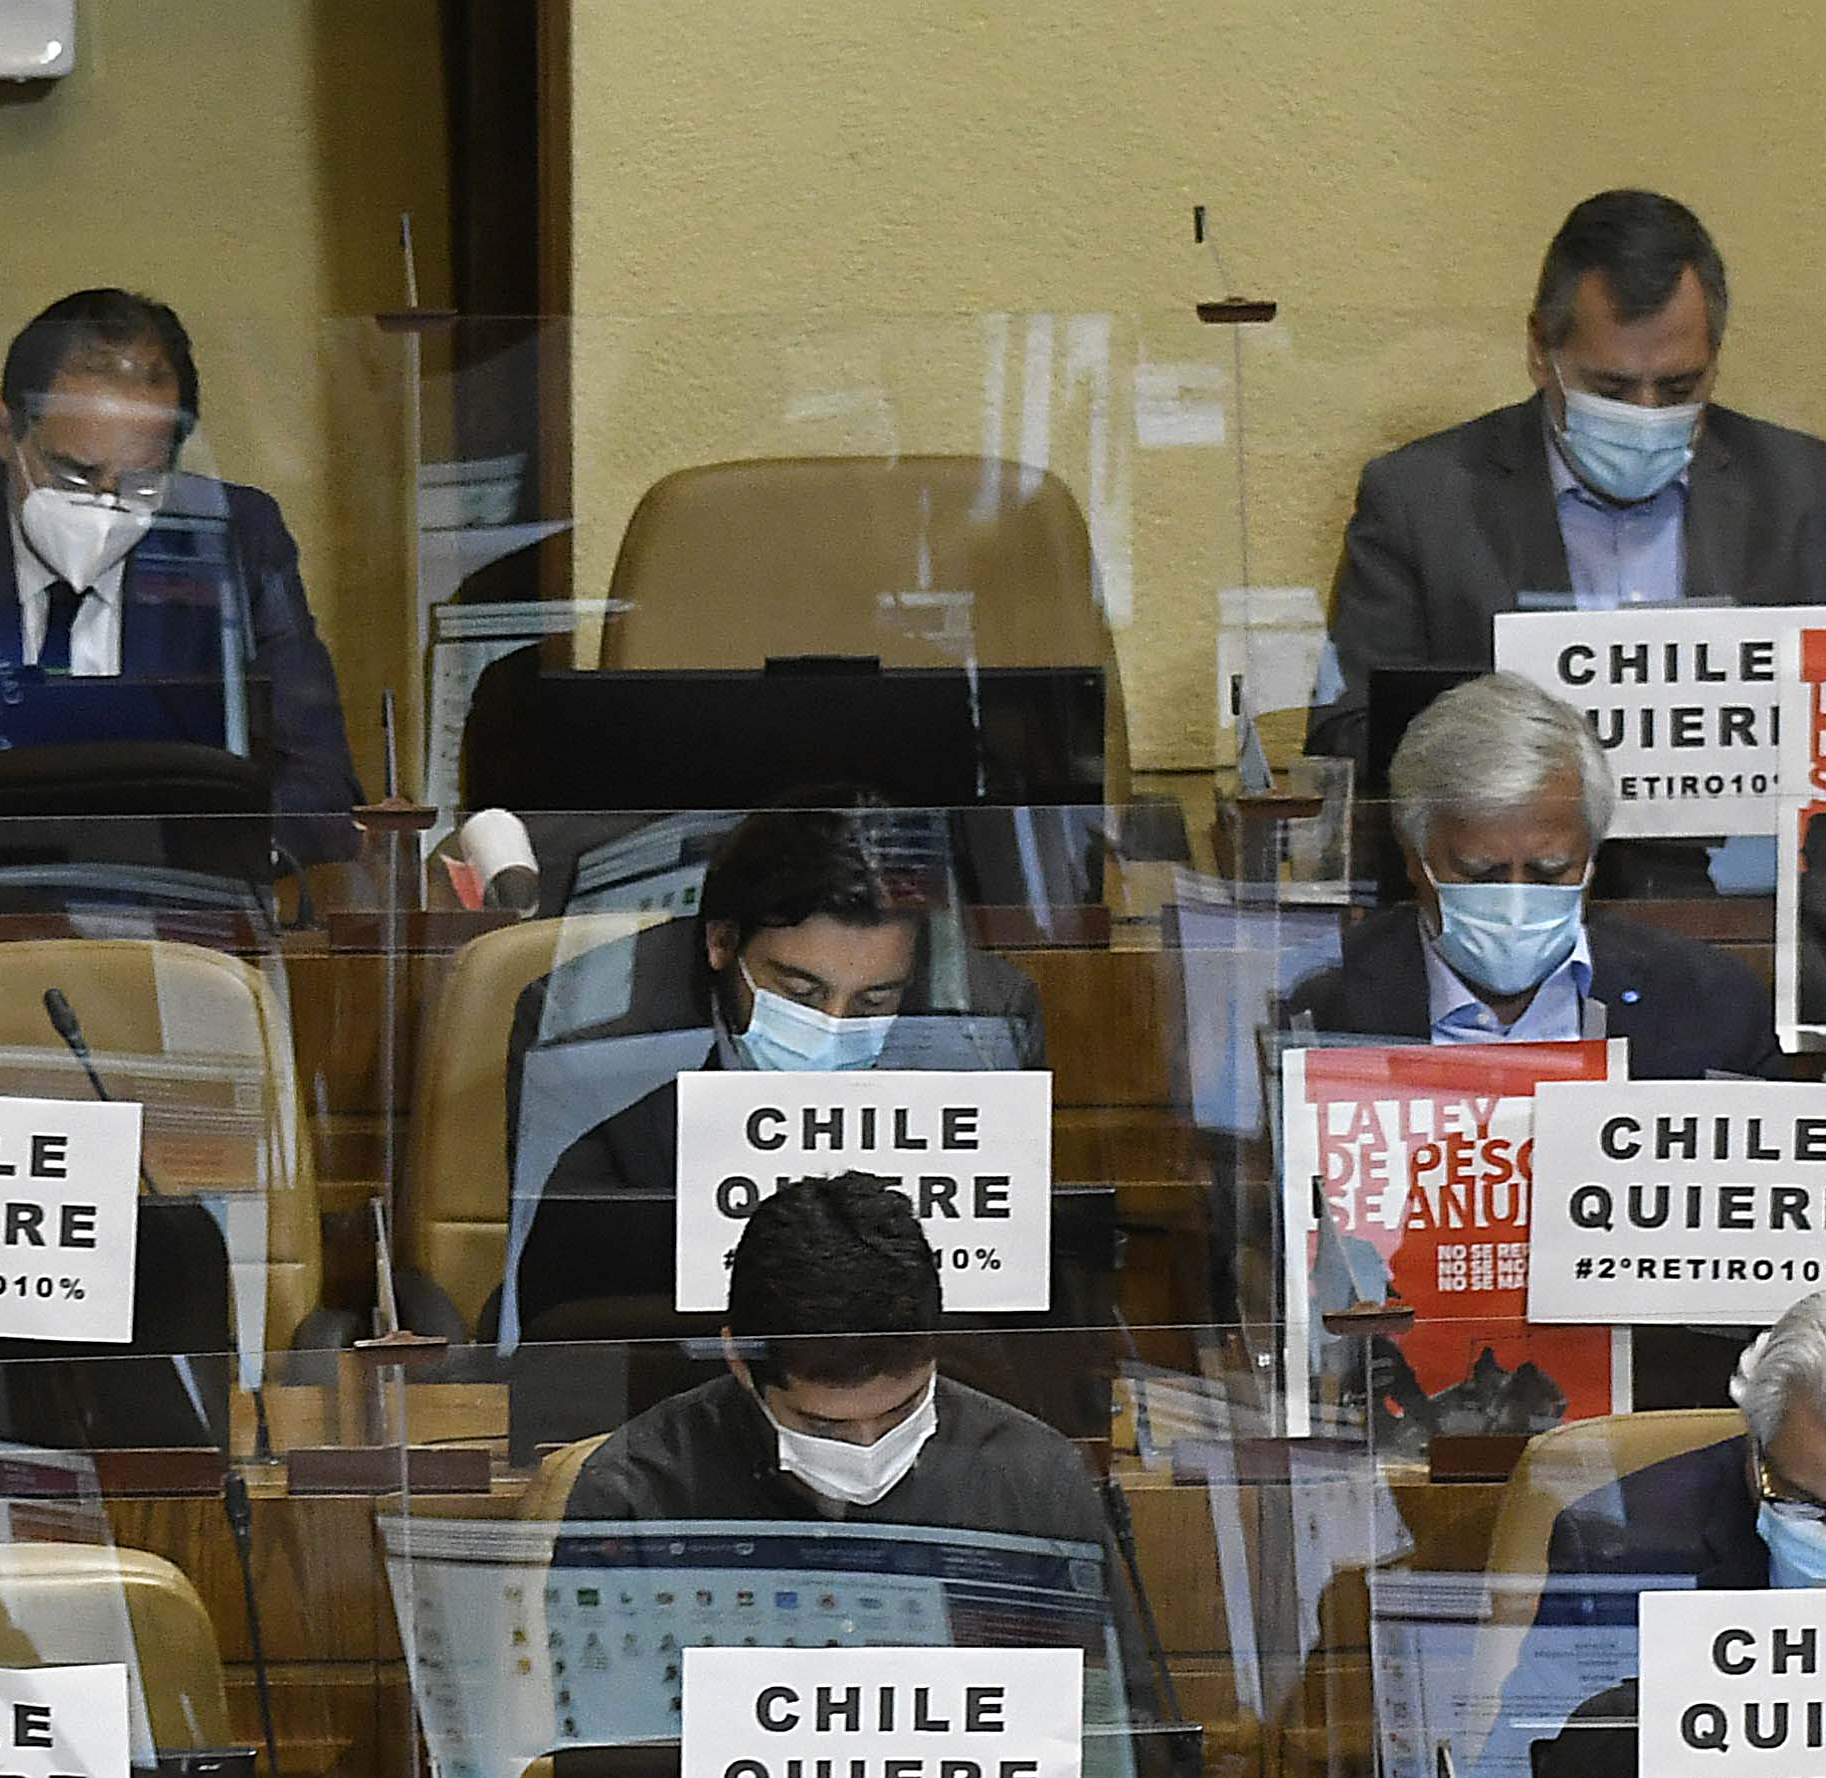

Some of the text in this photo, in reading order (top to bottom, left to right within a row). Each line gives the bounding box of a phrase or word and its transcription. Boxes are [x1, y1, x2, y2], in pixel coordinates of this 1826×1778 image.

[1558, 640, 1774, 686] CHILE
[1584, 706, 1779, 749] UIER
[747, 1108, 978, 1150] CHILE
[1318, 1098, 1499, 1149] LA LEY
[1320, 1141, 1389, 1185] DE
[1322, 1183, 1527, 1230] SE ANU
[756, 1687, 1004, 1732] CHILE
